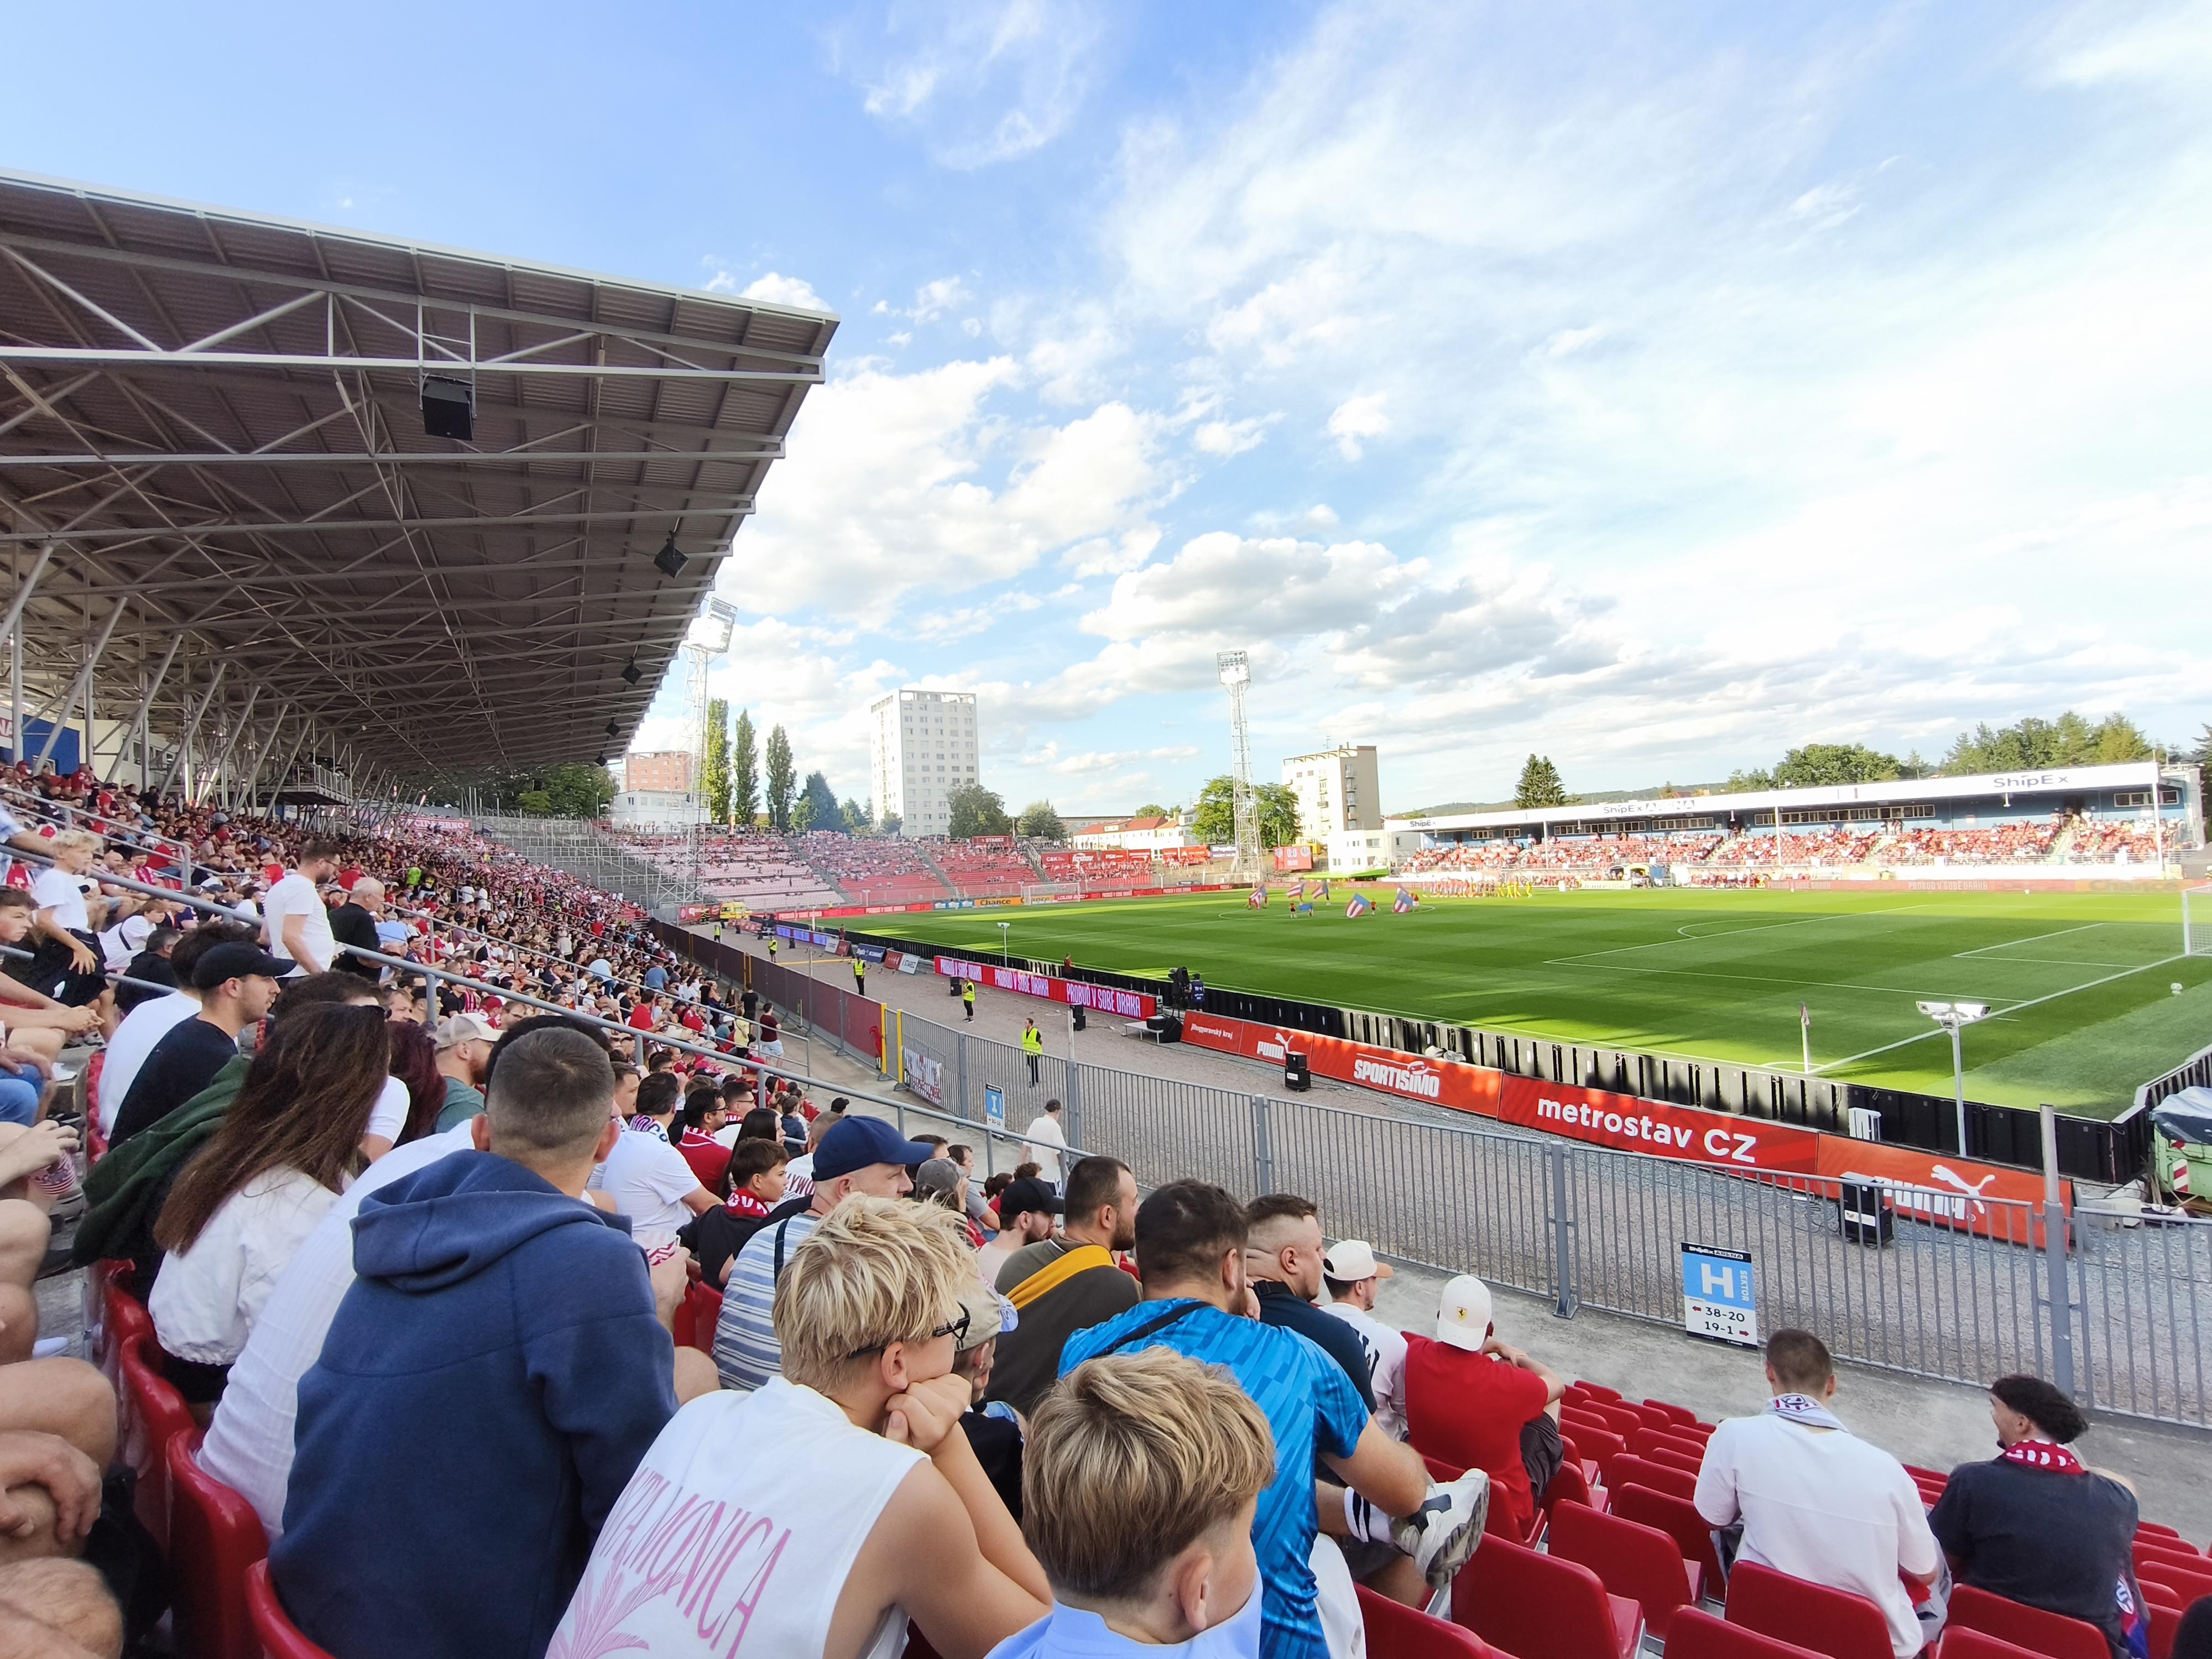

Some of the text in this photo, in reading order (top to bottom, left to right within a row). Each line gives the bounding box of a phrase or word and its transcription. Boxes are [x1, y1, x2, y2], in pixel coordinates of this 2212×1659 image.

[1994, 775, 2069, 788] ShipEx
[1604, 805, 1643, 815] ShipEx
[1117, 992, 1141, 1018] DRAKA
[1354, 1059, 1439, 1098] SPORTISIMO
[1537, 1098, 1756, 1163] metrostav CZ
[1715, 1250, 1742, 1259] ARENA
[1701, 1263, 1734, 1298] H
[1740, 1270, 1749, 1301] SEKTOR
[1705, 1306, 1745, 1322] 38-20
[1705, 1321, 1734, 1335] 19-1
